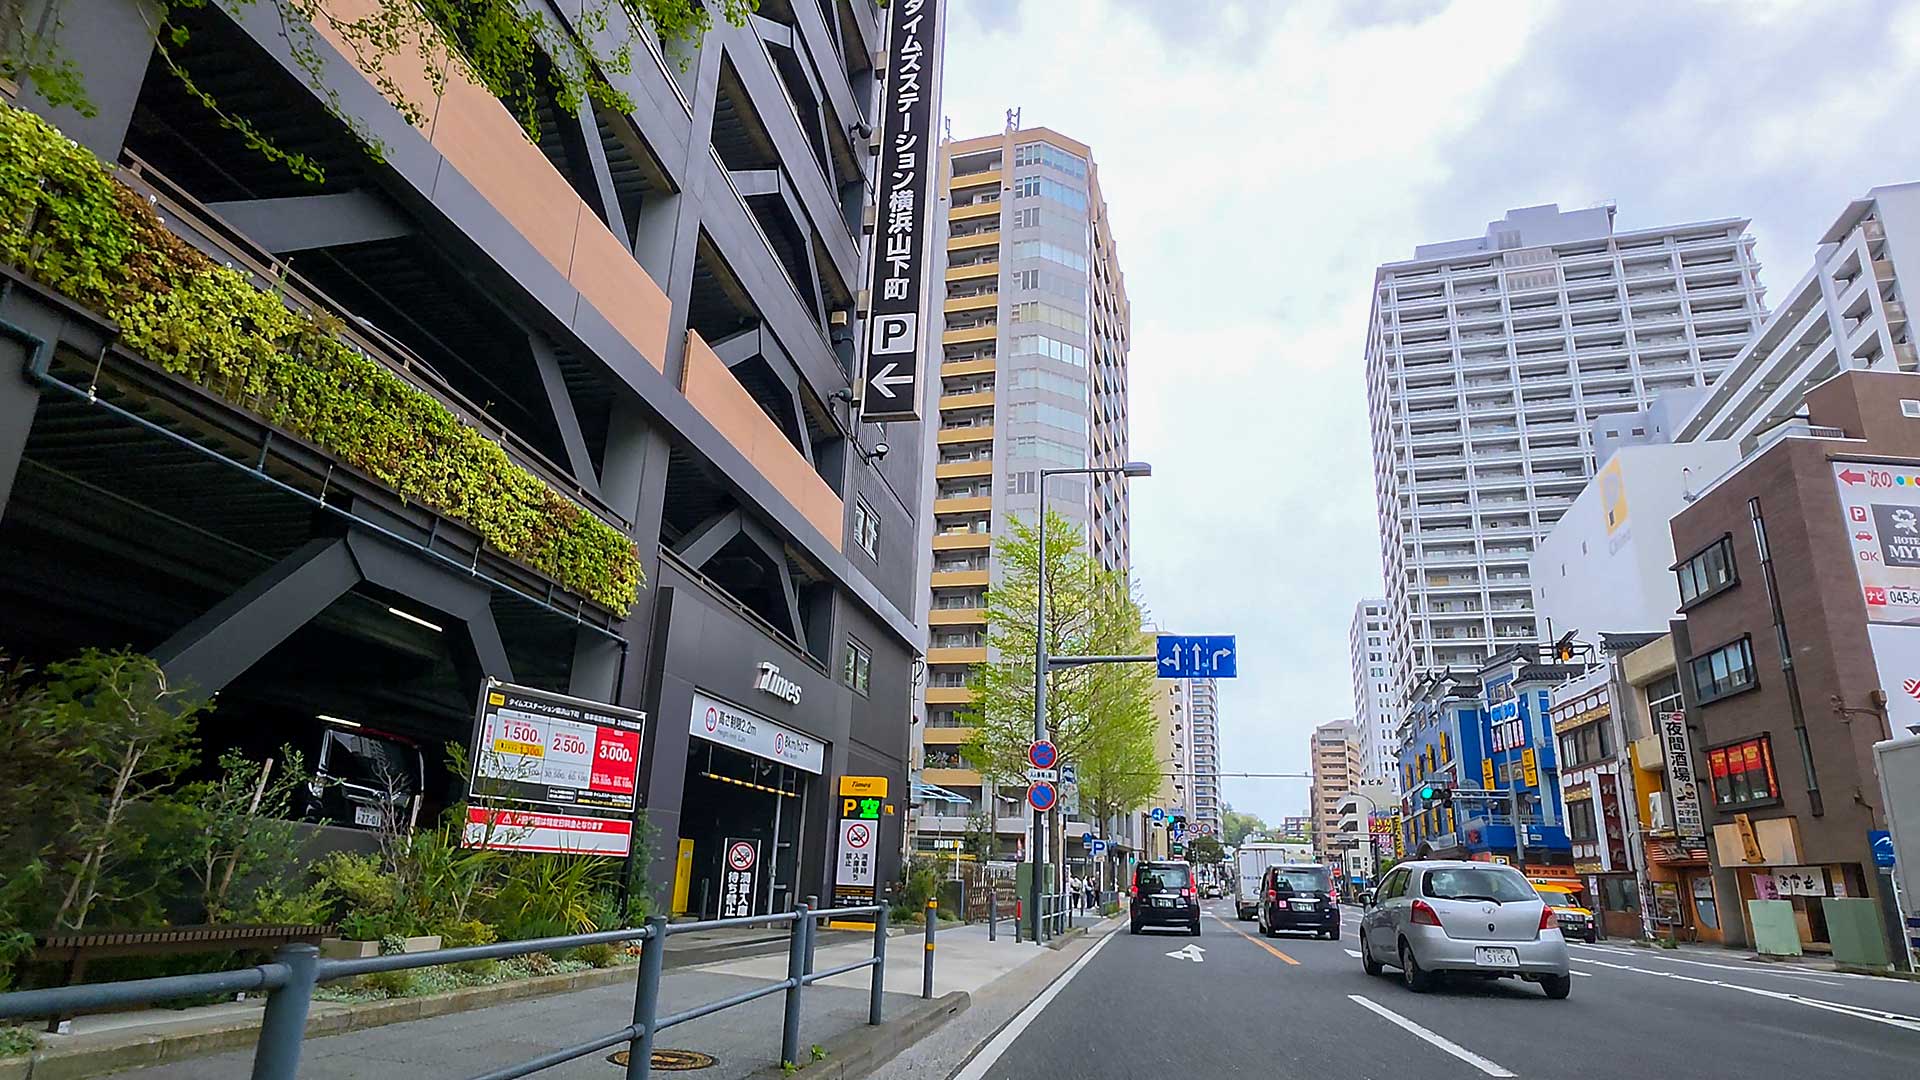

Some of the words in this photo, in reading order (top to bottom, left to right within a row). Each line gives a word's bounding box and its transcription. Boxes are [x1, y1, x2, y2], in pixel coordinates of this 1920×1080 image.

[884, 0, 924, 300] タイムズステーション横浜山下町
[881, 319, 907, 350] P
[1867, 469, 1893, 488] 次の
[1859, 550, 1879, 562] OK
[1866, 591, 1886, 603] ナビ
[1889, 590, 1920, 605] 045-6
[758, 661, 803, 705] Times
[1665, 721, 1691, 783] 夜間酒場
[843, 798, 858, 818] P
[1093, 841, 1106, 855] P
[724, 871, 740, 917] 待ち禁止
